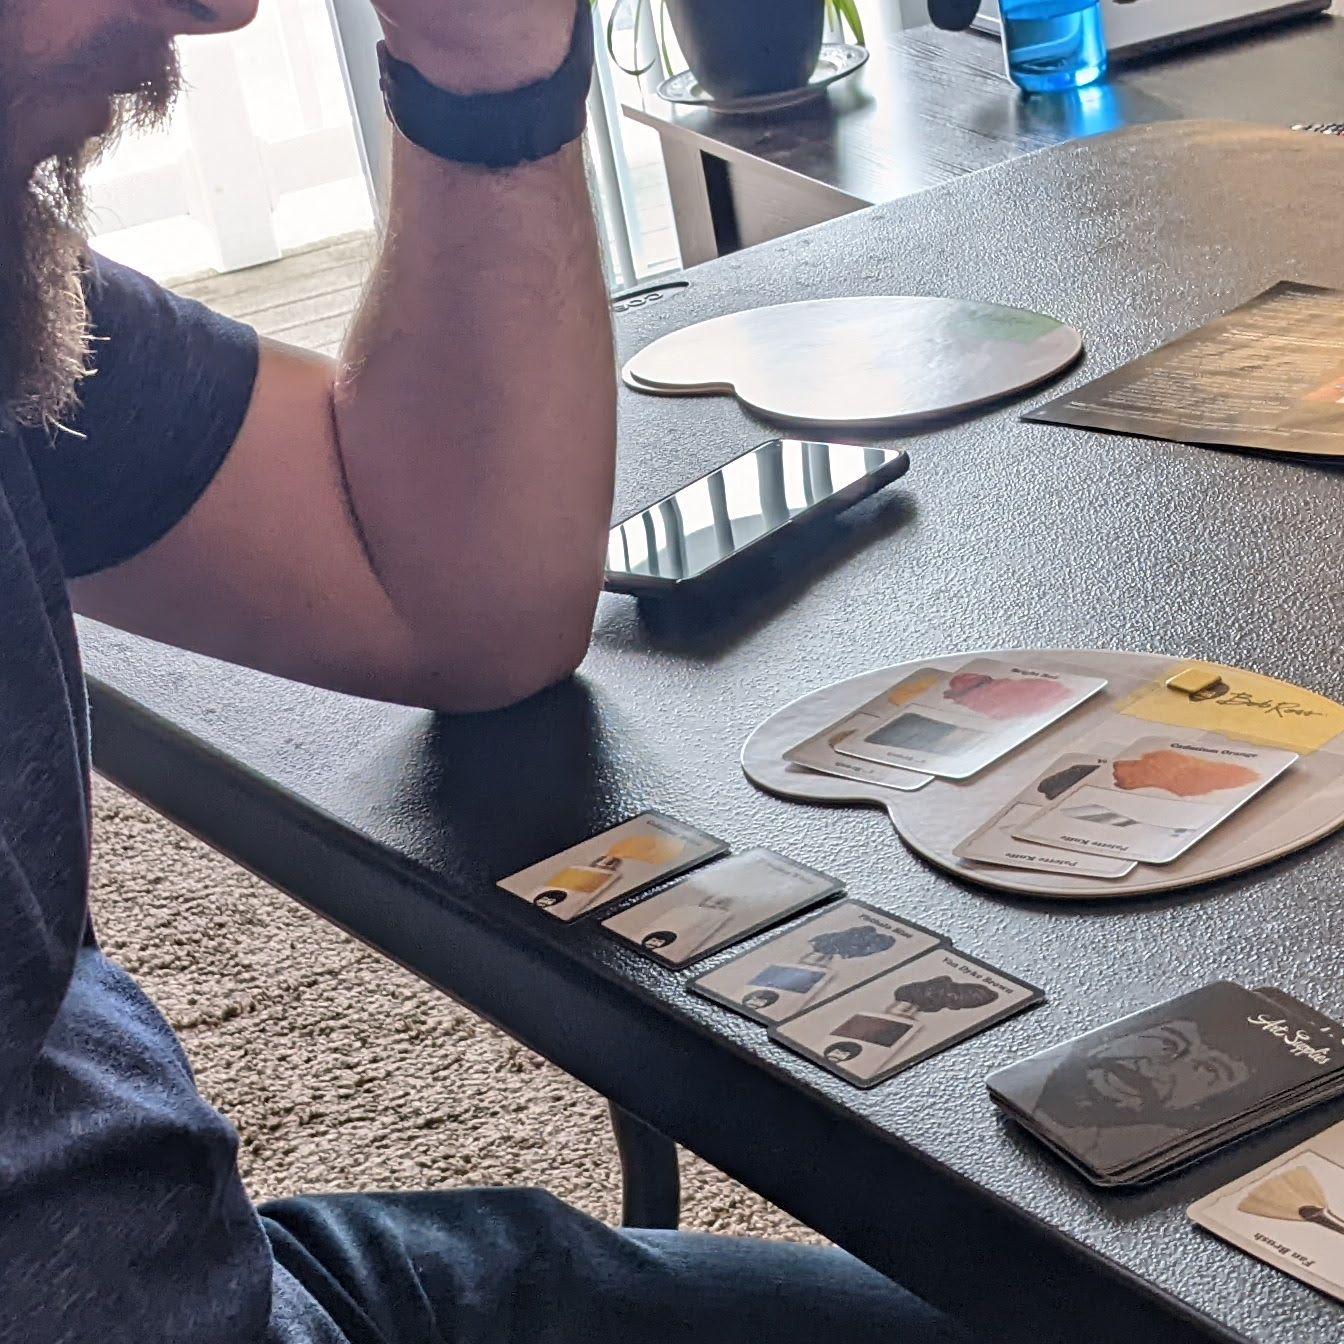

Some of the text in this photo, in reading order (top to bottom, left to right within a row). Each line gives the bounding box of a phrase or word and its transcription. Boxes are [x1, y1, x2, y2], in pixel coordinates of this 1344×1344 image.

[1216, 692, 1273, 708] Bob
[1170, 742, 1218, 754] Cadmium
[958, 965, 983, 980] Dyke
[982, 976, 1014, 994] Brown
[1247, 1014, 1288, 1036] Art
[1283, 1029, 1331, 1064] Supplies
[1254, 1232, 1316, 1267] Fan Brush
